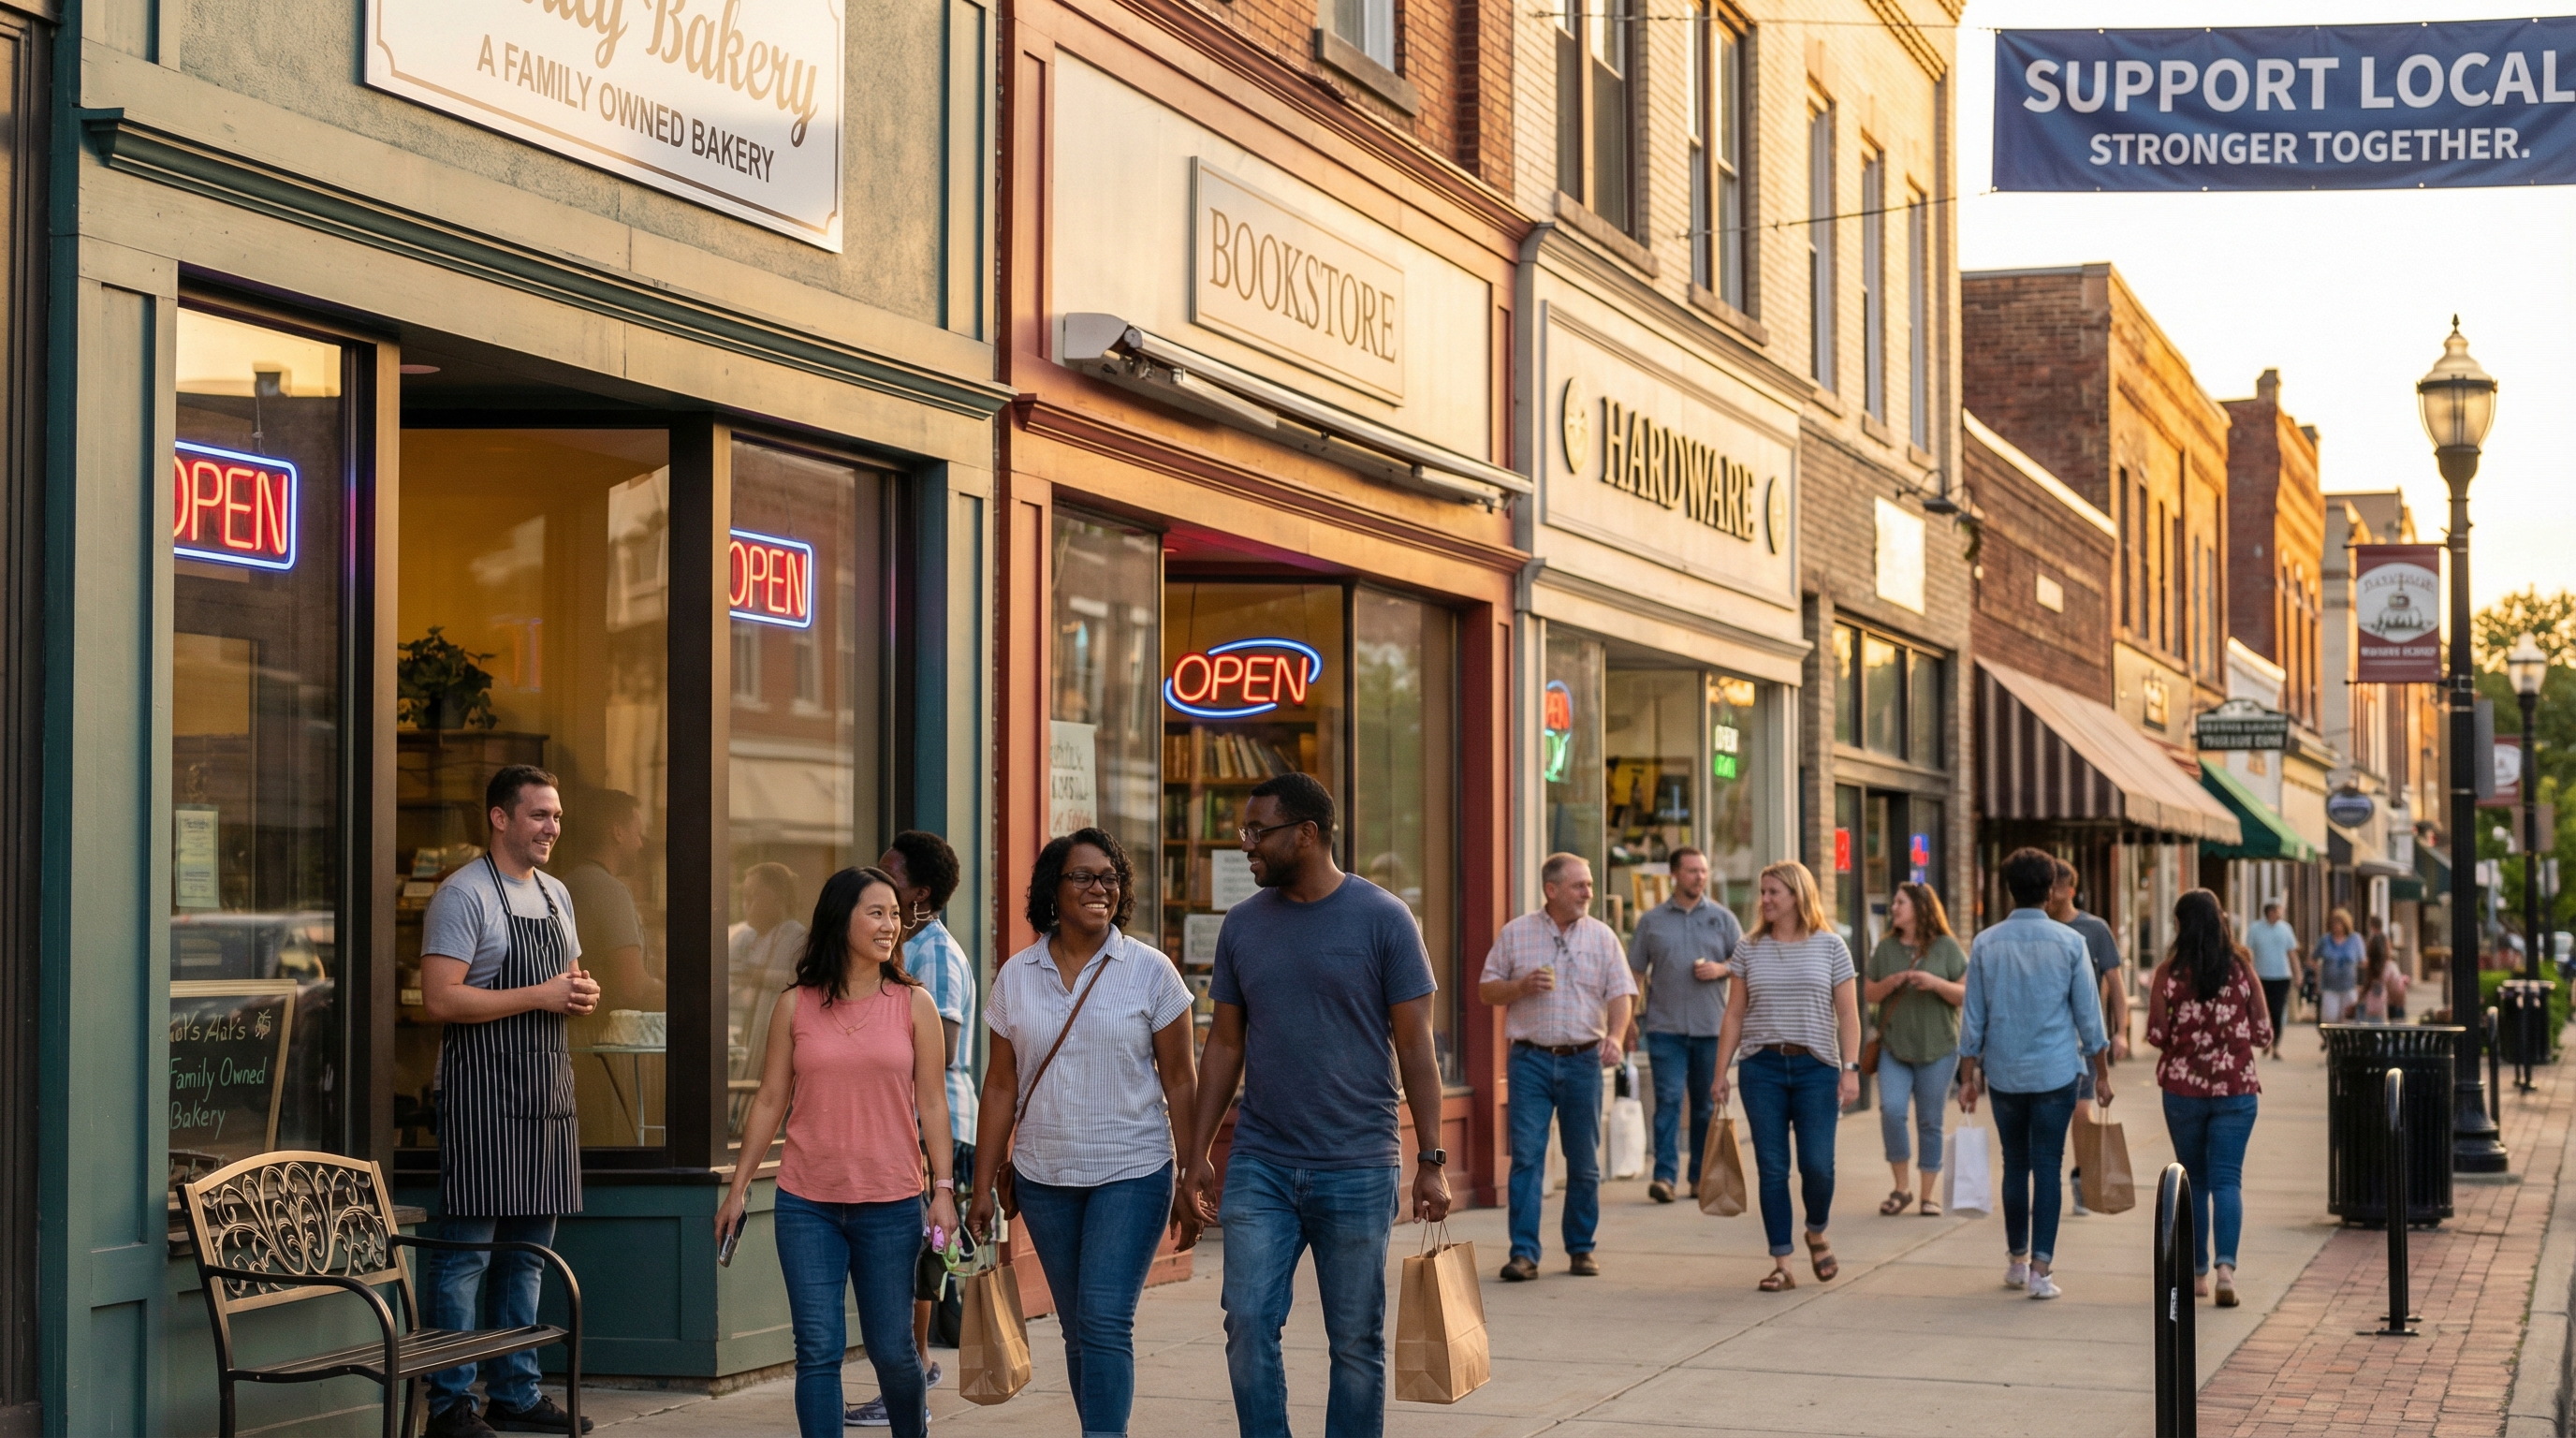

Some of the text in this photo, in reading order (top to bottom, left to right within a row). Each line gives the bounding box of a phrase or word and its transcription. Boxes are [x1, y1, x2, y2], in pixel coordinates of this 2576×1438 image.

[476, 34, 496, 78] A
[504, 41, 593, 112] FAMILY
[599, 81, 685, 148] OWNED
[692, 118, 775, 183] BAKERY
[646, 0, 819, 148] Bakery
[2022, 50, 2576, 113] SUPPORT LOCAL
[2089, 127, 2530, 166] STRONGER TOGETHER.
[1209, 207, 1397, 364] BOOKSTORE
[1602, 396, 1755, 543] HARDWARE
[729, 540, 807, 617] OPEN
[1172, 653, 1309, 704] OPEN
[169, 1056, 268, 1103] Family Owned
[169, 1100, 227, 1140] Bakery
